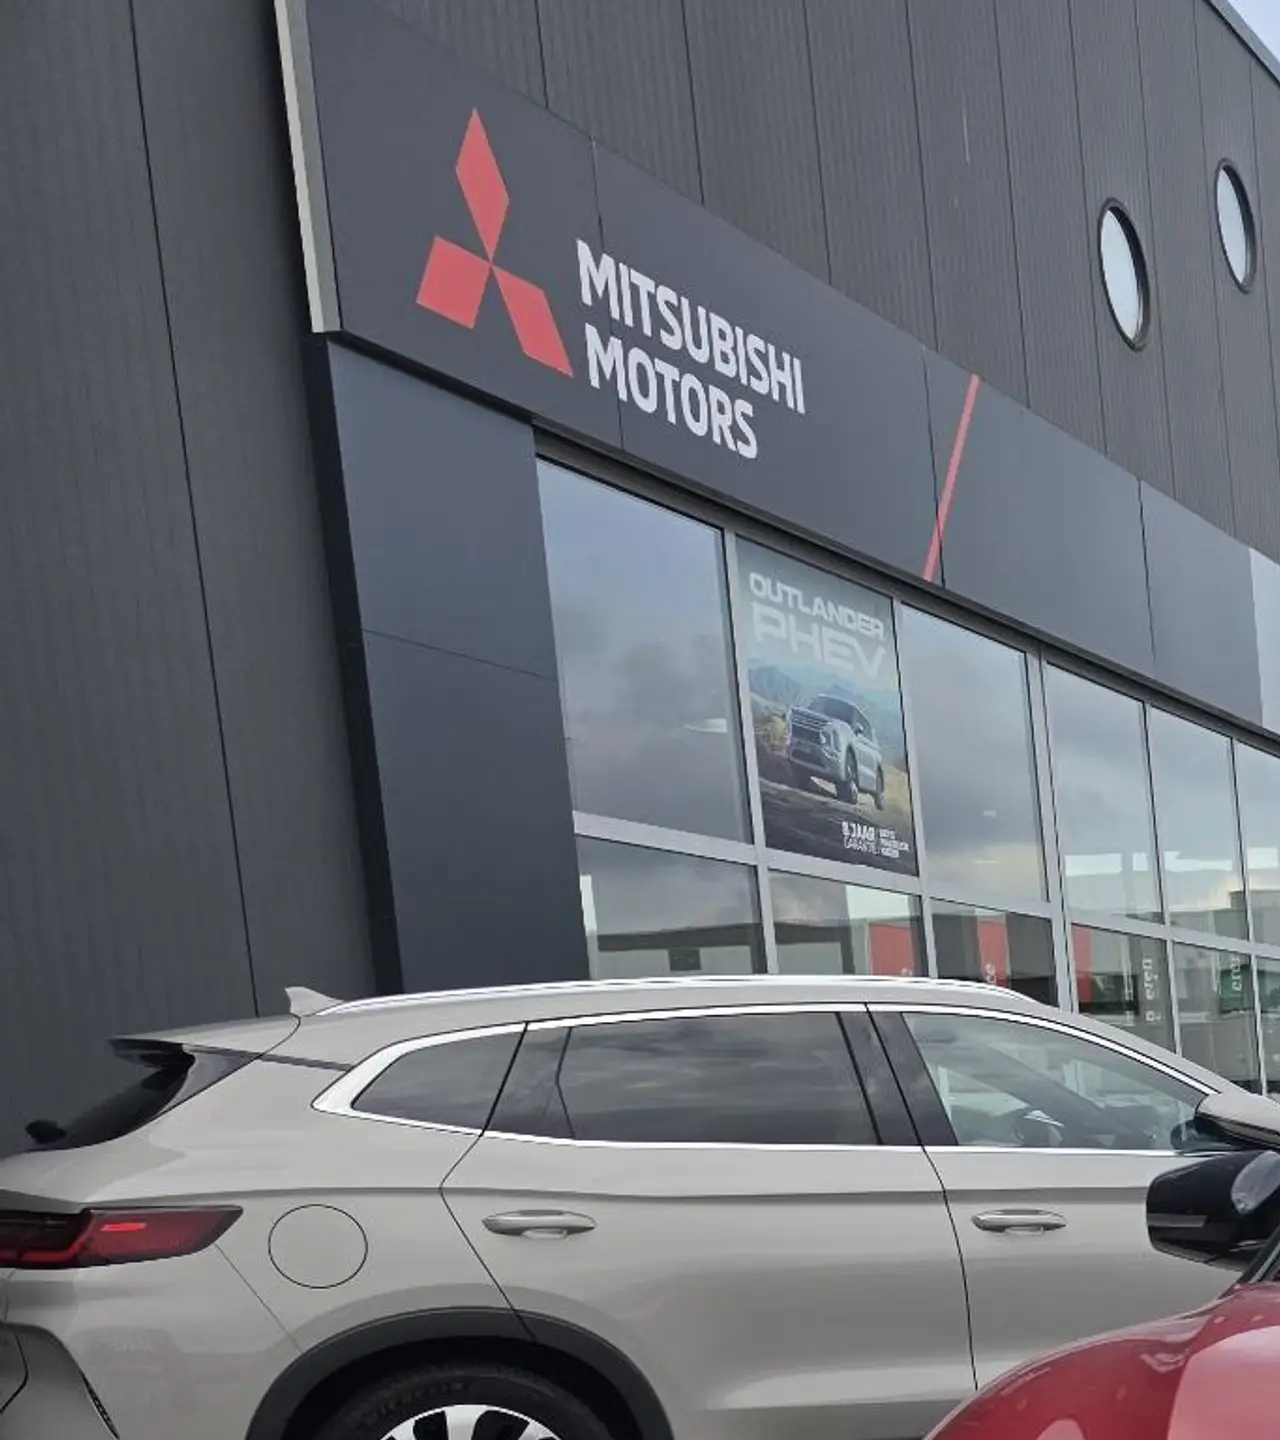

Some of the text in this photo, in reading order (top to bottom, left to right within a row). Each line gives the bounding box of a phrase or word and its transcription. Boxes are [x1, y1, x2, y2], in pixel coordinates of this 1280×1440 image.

[576, 239, 805, 414] MITSUBISHI
[585, 323, 757, 459] MOTORS
[750, 572, 886, 641] OUTLANDER
[752, 602, 886, 677] PHEV
